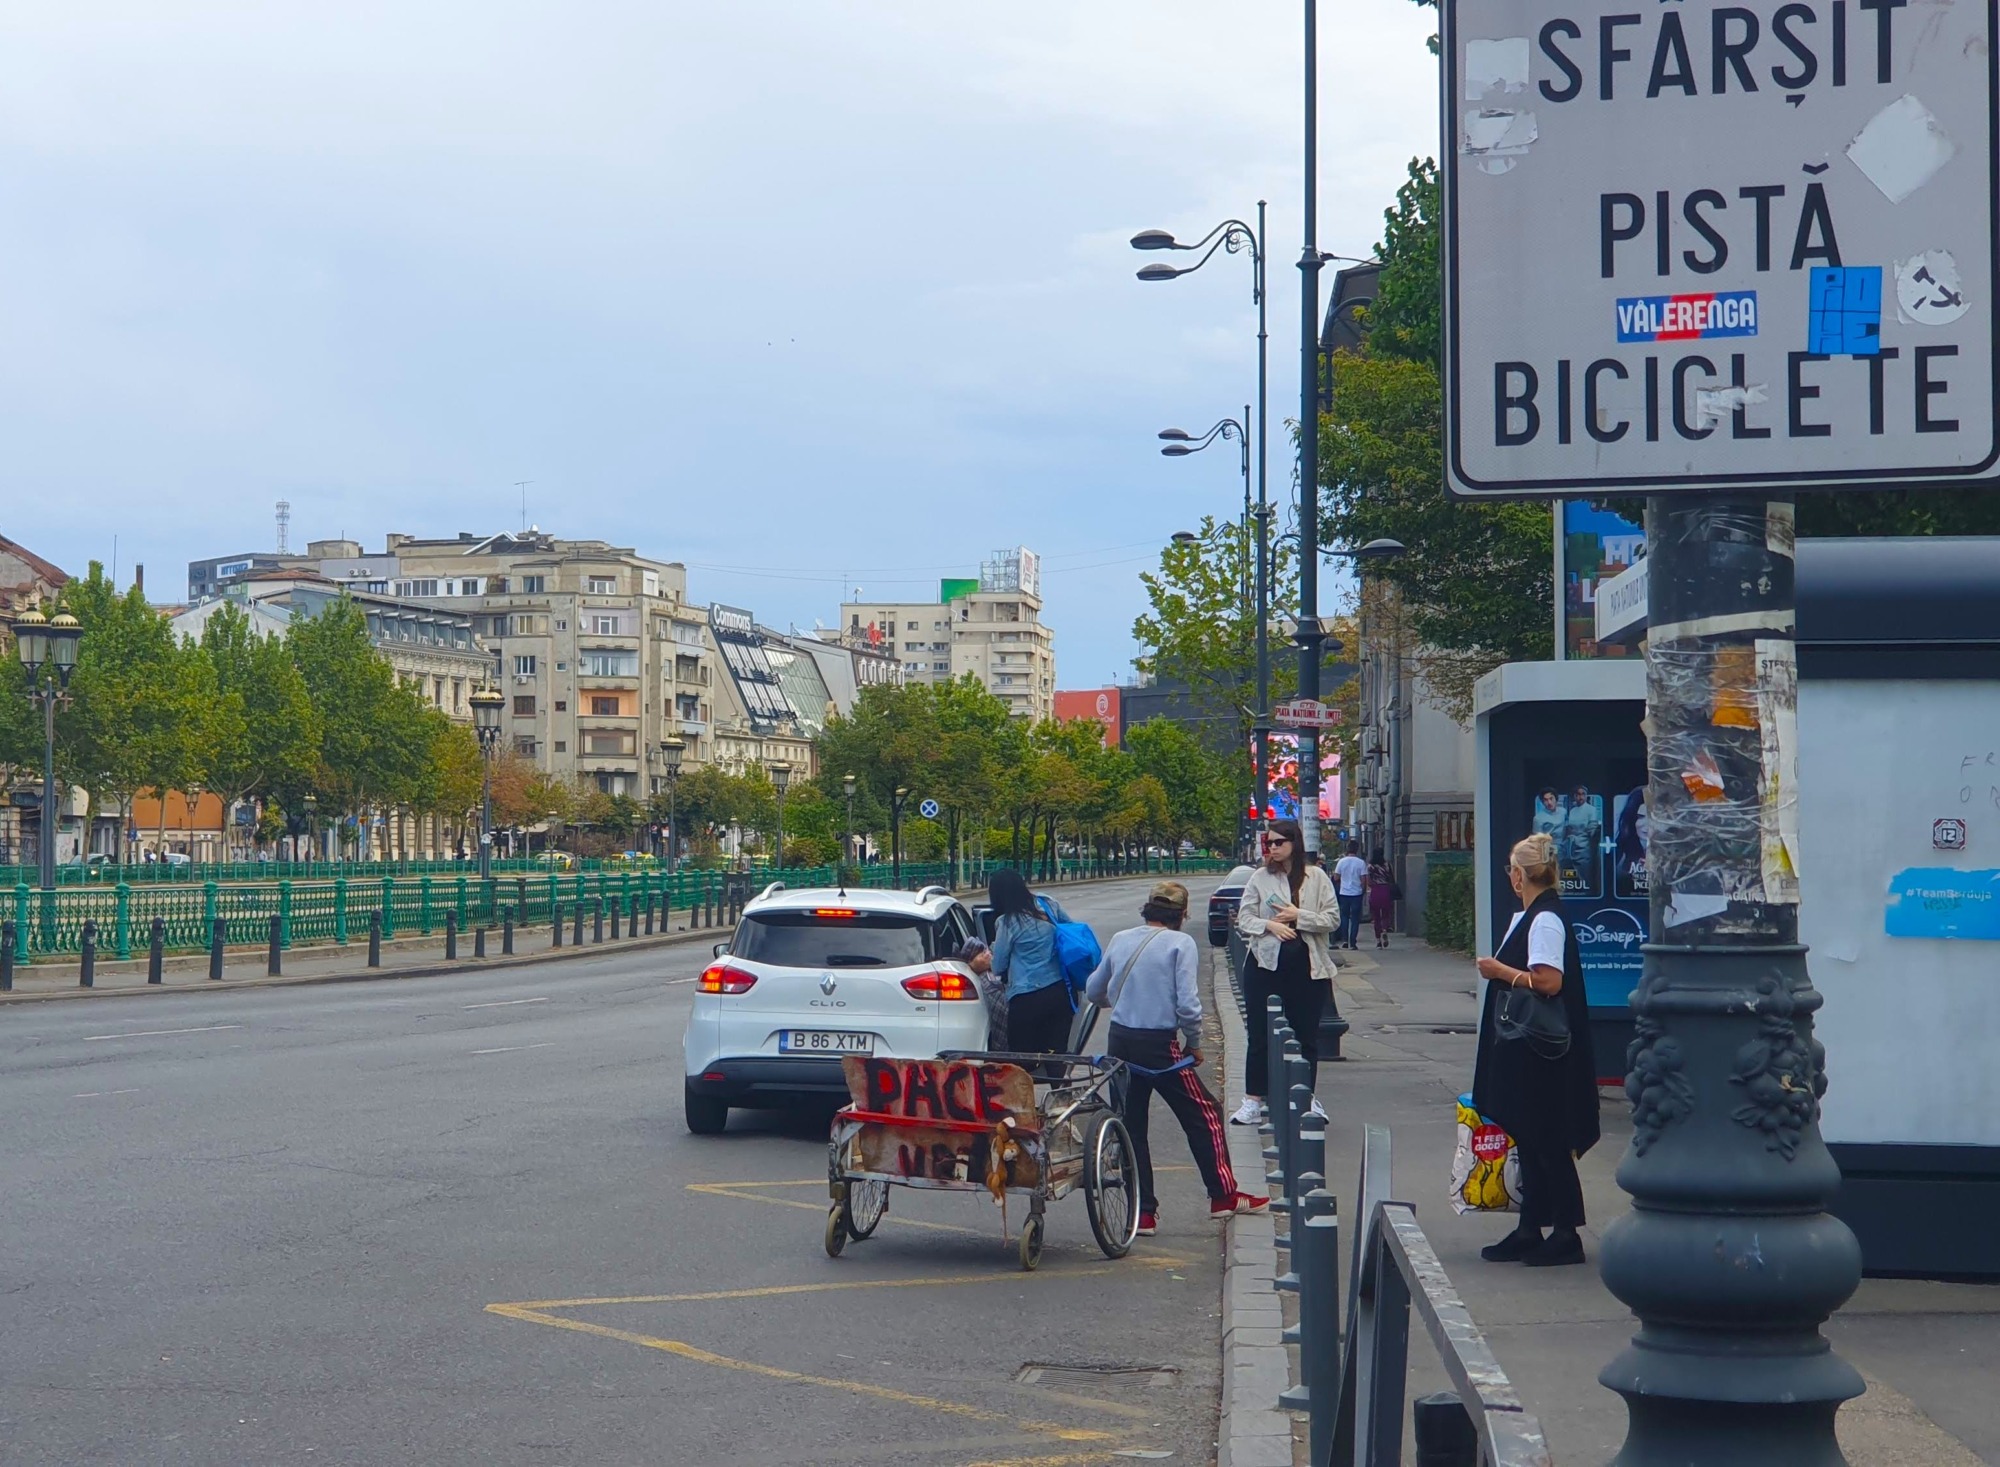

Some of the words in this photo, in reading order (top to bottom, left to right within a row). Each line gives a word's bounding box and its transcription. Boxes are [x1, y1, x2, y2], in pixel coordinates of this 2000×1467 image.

[1600, 162, 1843, 278] PISTĂ
[1618, 299, 1755, 334] VÅLERENGA
[1494, 345, 1959, 447] BICICLETE
[714, 604, 751, 631] Commons
[1559, 880, 1590, 889] RSUL
[1728, 891, 1766, 903] AGAINS
[794, 1033, 805, 1047] B
[811, 1034, 829, 1048] 86
[836, 1034, 867, 1050] XTM
[1484, 1134, 1506, 1143] FEEL
